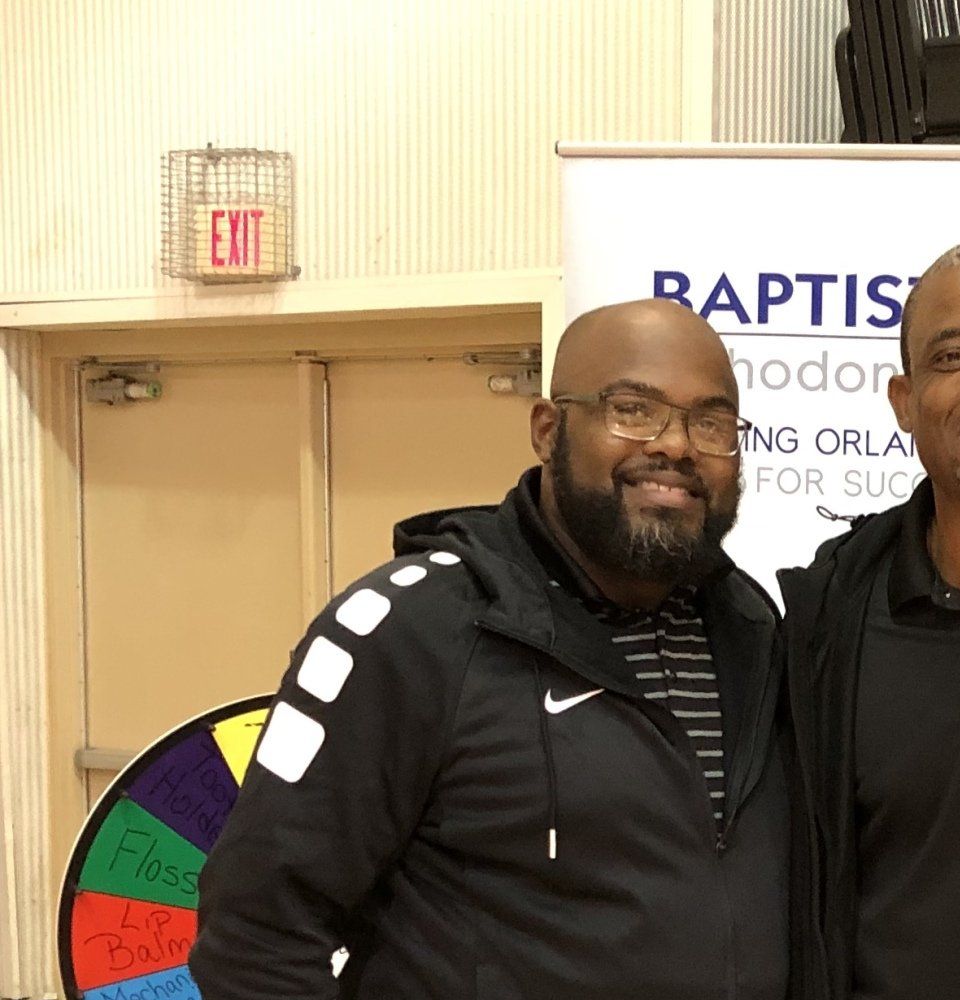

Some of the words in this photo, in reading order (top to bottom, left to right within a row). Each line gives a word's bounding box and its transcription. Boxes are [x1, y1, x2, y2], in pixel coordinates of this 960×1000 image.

[211, 209, 264, 266] EXIT
[654, 270, 921, 329] BAPTIS
[756, 466, 825, 495] FOR
[109, 828, 199, 896] Floss
[84, 931, 191, 971] Balm
